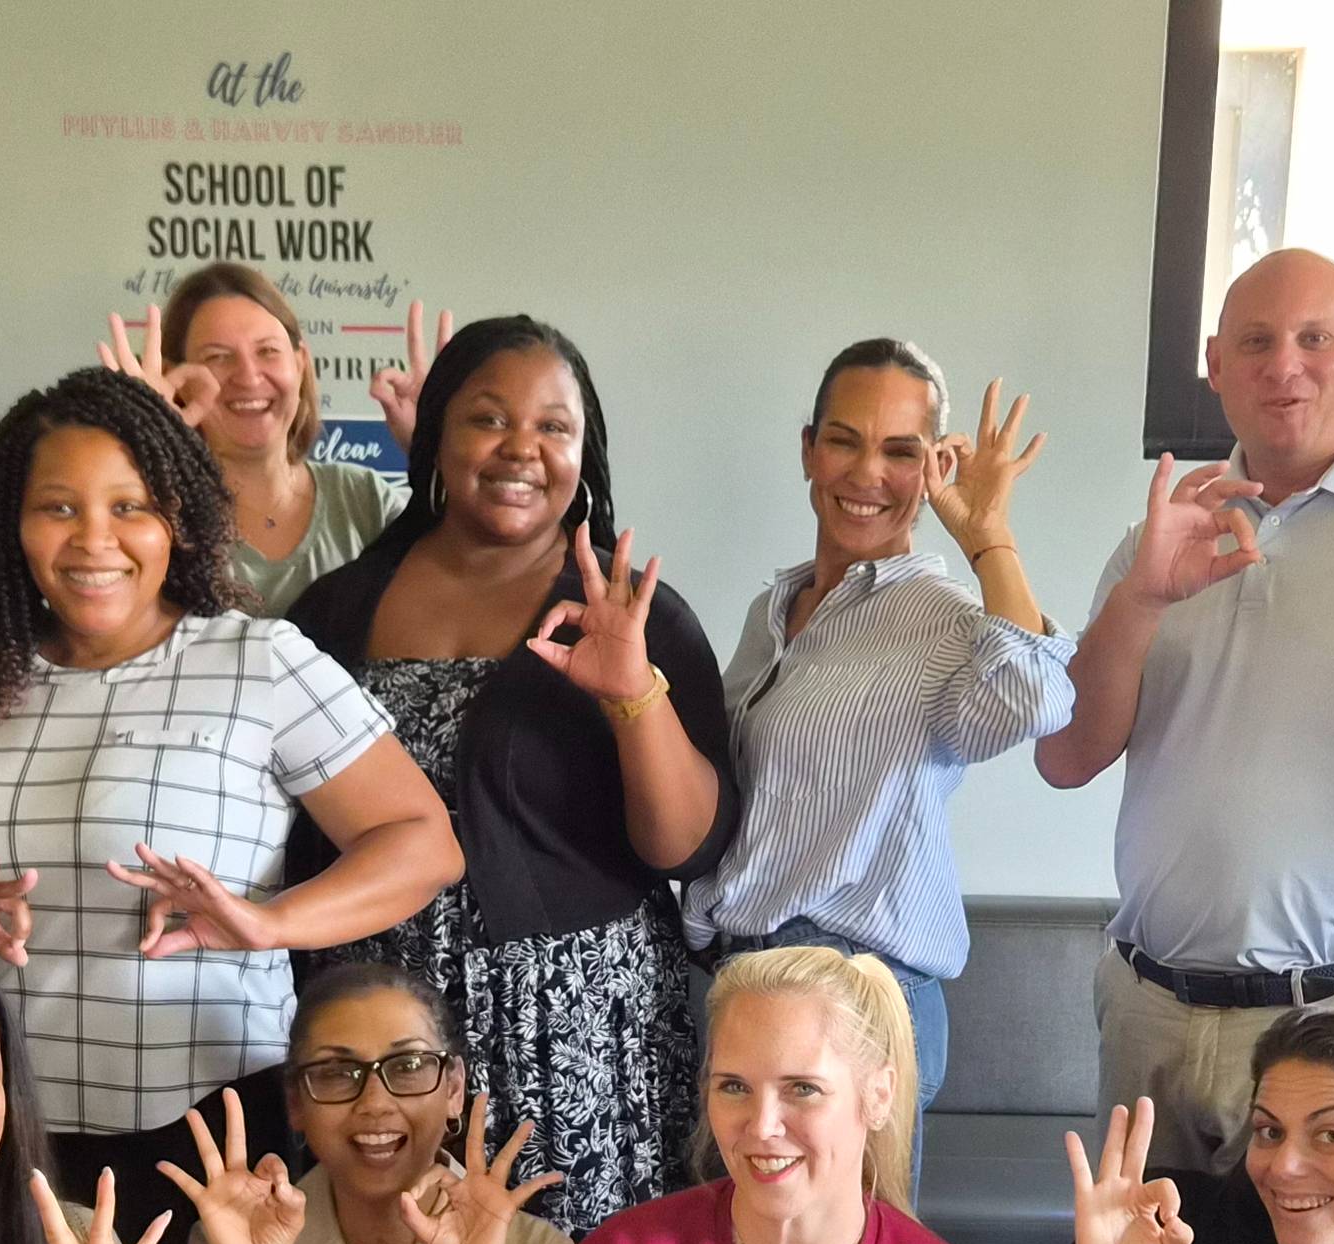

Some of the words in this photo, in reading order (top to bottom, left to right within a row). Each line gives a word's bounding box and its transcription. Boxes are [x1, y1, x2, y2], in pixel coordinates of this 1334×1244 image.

[255, 51, 306, 108] the
[62, 113, 175, 141] PHYLLIS
[184, 117, 205, 141] &
[212, 117, 328, 145] HARVEY
[336, 121, 464, 147] SANDLER
[163, 161, 296, 208] SCHOOL
[305, 163, 347, 209] OF
[147, 215, 266, 260] SOCIAL
[276, 218, 374, 263] WORK
[314, 427, 382, 463] clean
